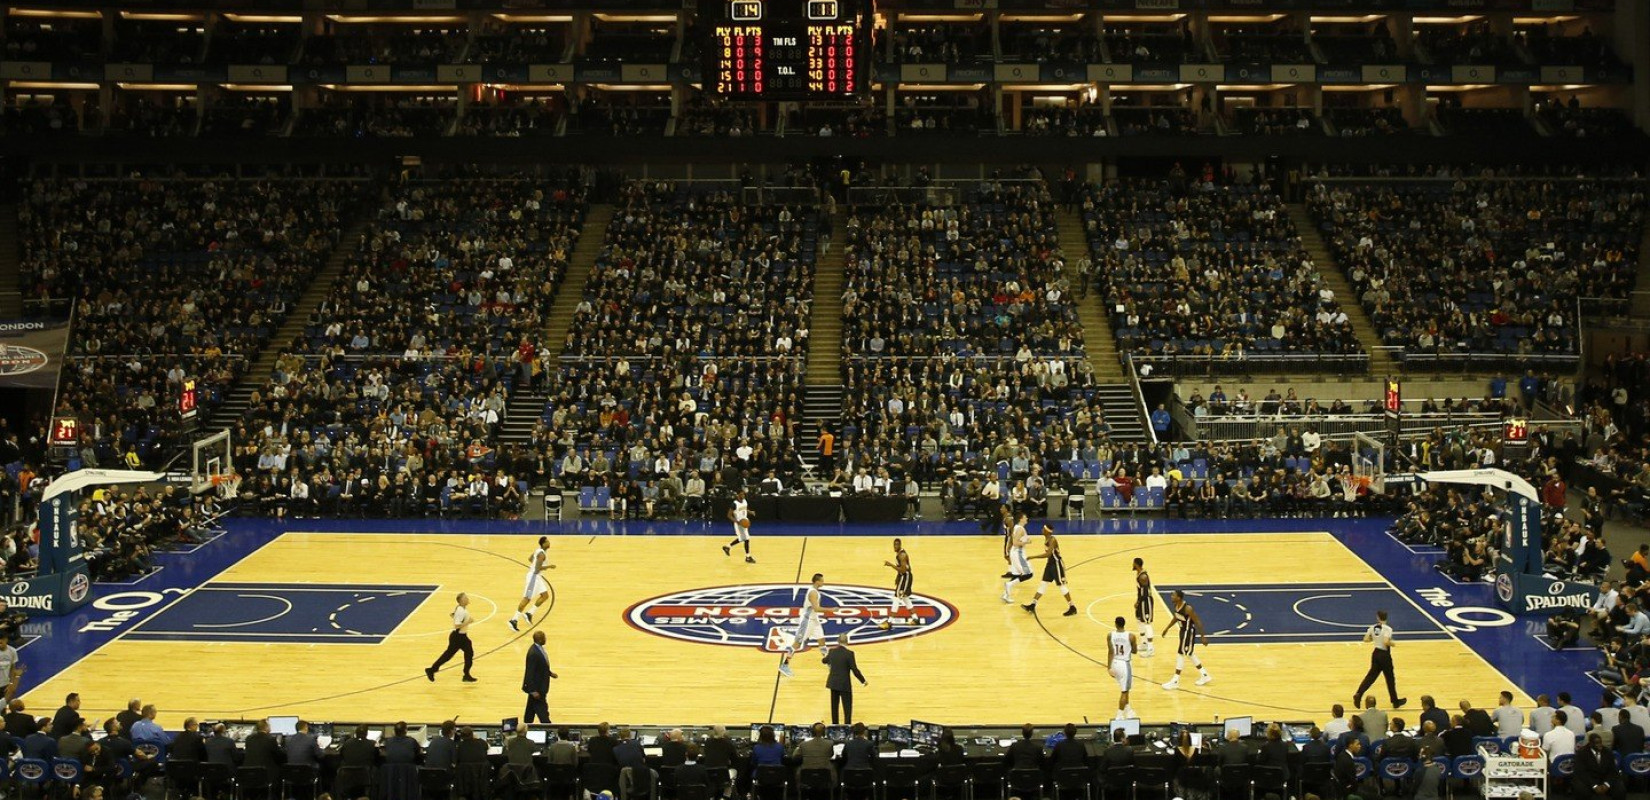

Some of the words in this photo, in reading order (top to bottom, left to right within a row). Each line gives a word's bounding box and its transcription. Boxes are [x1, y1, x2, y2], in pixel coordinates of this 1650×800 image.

[744, 4, 758, 16] 14
[821, 3, 835, 16] 11
[716, 27, 731, 37] PLY
[734, 27, 744, 36] FL
[746, 27, 761, 36] PTS
[808, 26, 823, 36] PLY
[826, 26, 836, 35] FL
[837, 26, 853, 36] PTS
[724, 36, 731, 46] 0
[737, 36, 743, 46] 0
[755, 36, 761, 46] 3
[773, 38, 783, 46] TM
[784, 38, 796, 46] FLS
[811, 36, 822, 45] 13
[845, 35, 853, 45] 2
[724, 47, 731, 57] 8
[737, 47, 744, 57] 0
[754, 47, 762, 57] 9
[808, 47, 823, 57] 21
[828, 47, 835, 57] 0
[846, 47, 853, 57] 0
[721, 60, 731, 69] 14
[737, 59, 744, 69] 0
[754, 60, 761, 69] 2
[809, 59, 823, 69] 33
[828, 59, 835, 69] 0
[846, 59, 853, 69] 0
[778, 66, 795, 75] T.O.L.
[809, 70, 823, 80] 40
[828, 70, 835, 80] 0
[846, 70, 853, 80] 2
[721, 71, 731, 80] 15
[737, 71, 744, 81] 0
[754, 71, 762, 81] 0
[717, 83, 732, 93] 21
[755, 82, 762, 92] 0
[809, 82, 823, 91] 44
[828, 82, 835, 92] 0
[846, 82, 853, 92] 2
[182, 391, 194, 410] 21
[1388, 391, 1398, 410] 21
[59, 428, 72, 439] 21
[1510, 428, 1523, 439] 21
[1415, 587, 1454, 607] The
[1525, 592, 1591, 612] SPALDING
[78, 610, 139, 632] The
[654, 616, 748, 624] GAMES
[1115, 644, 1124, 656] 14
